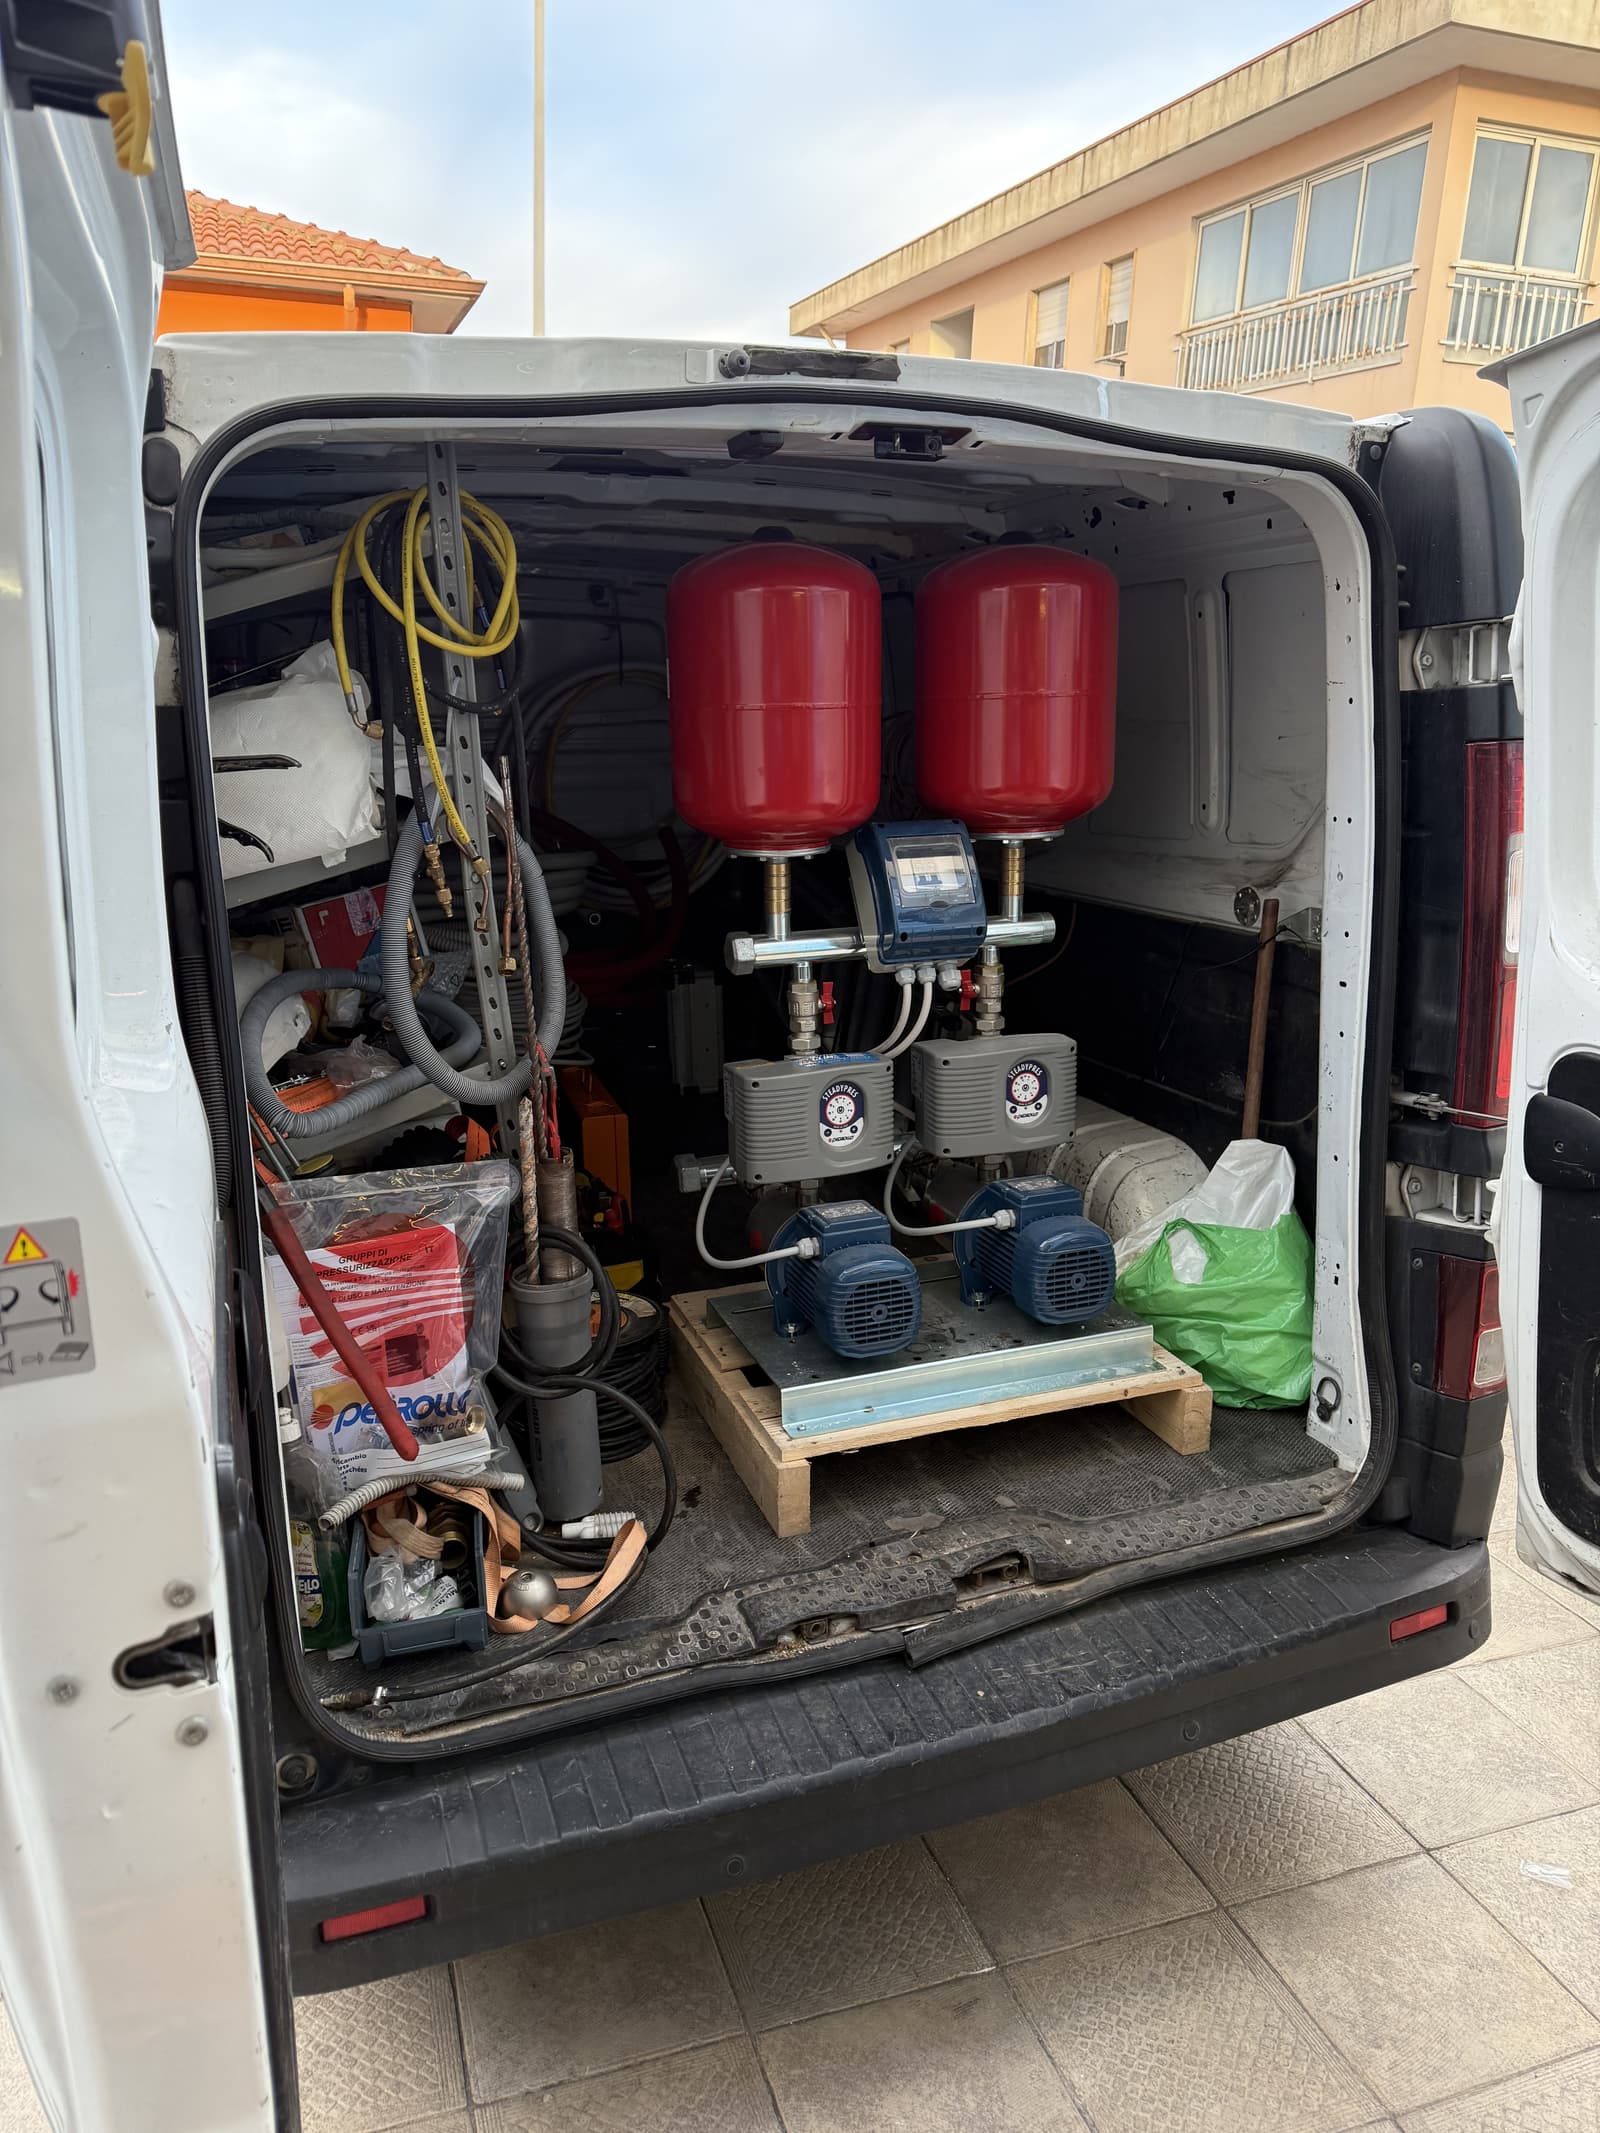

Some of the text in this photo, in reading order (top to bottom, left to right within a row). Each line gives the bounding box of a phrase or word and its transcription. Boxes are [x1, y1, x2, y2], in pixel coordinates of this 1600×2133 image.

[1008, 1063, 1043, 1080] STEADYPRES
[822, 1084, 859, 1101] STEADYPRES
[338, 1248, 387, 1264] GRUPPI DI
[425, 1245, 434, 1254] IT
[316, 1254, 413, 1278] PRESSURIZZAZIONE
[298, 1578, 320, 1594] ELLO
